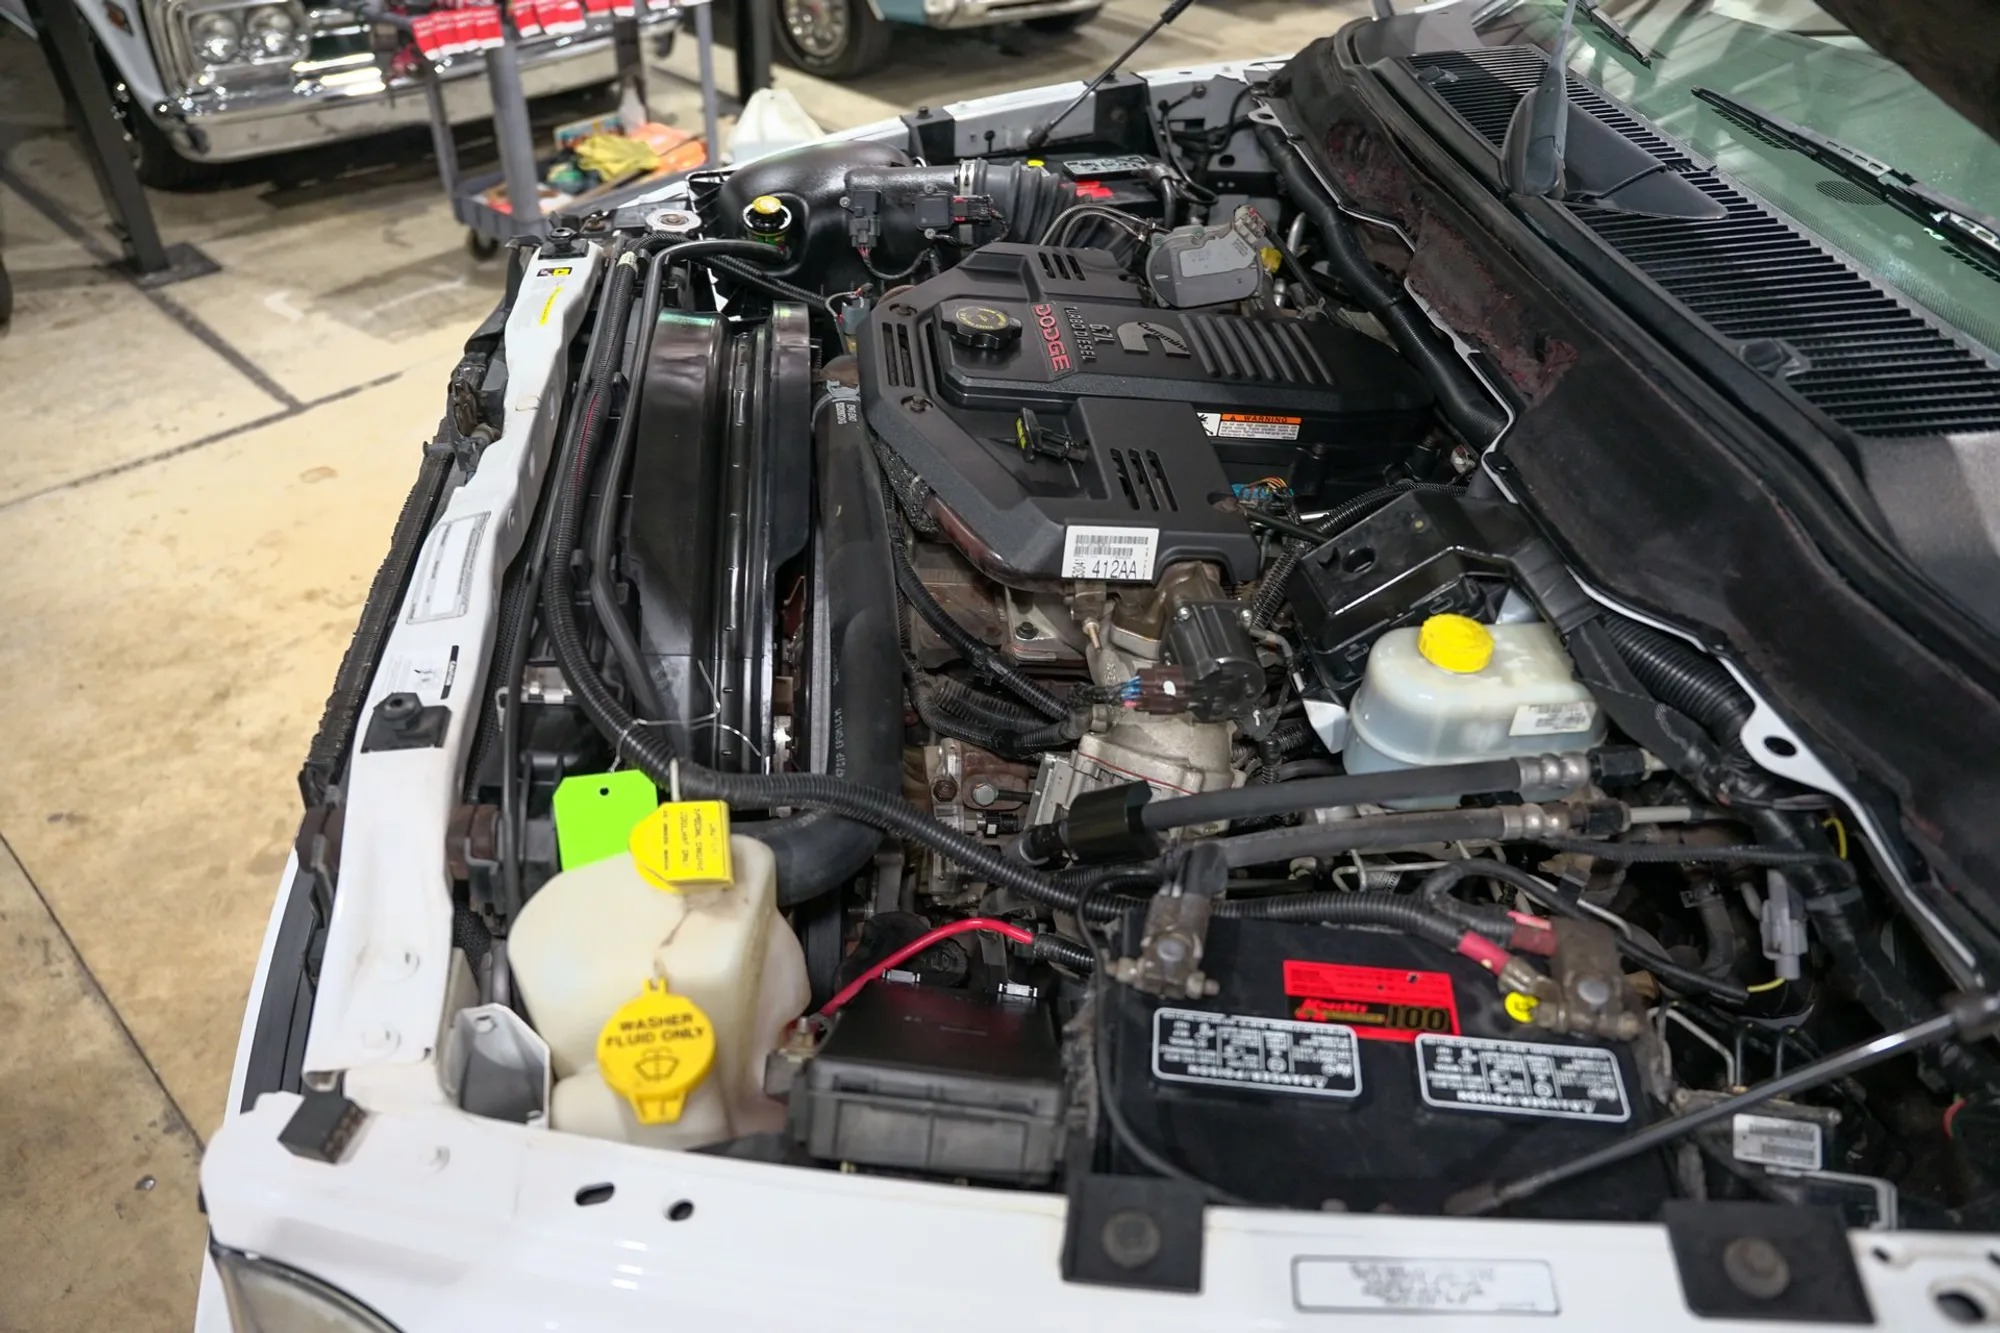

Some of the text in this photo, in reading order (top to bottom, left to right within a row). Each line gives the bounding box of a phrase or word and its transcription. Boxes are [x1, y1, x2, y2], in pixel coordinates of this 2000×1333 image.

[1033, 303, 1071, 372] DODGE
[1137, 321, 1188, 352] Cummins
[1243, 415, 1288, 424] WARNING
[1092, 560, 1137, 579] 412AA
[620, 1013, 693, 1031] WASHER
[1389, 1006, 1447, 1031] 100
[606, 1027, 704, 1048] FLUID ONLY
